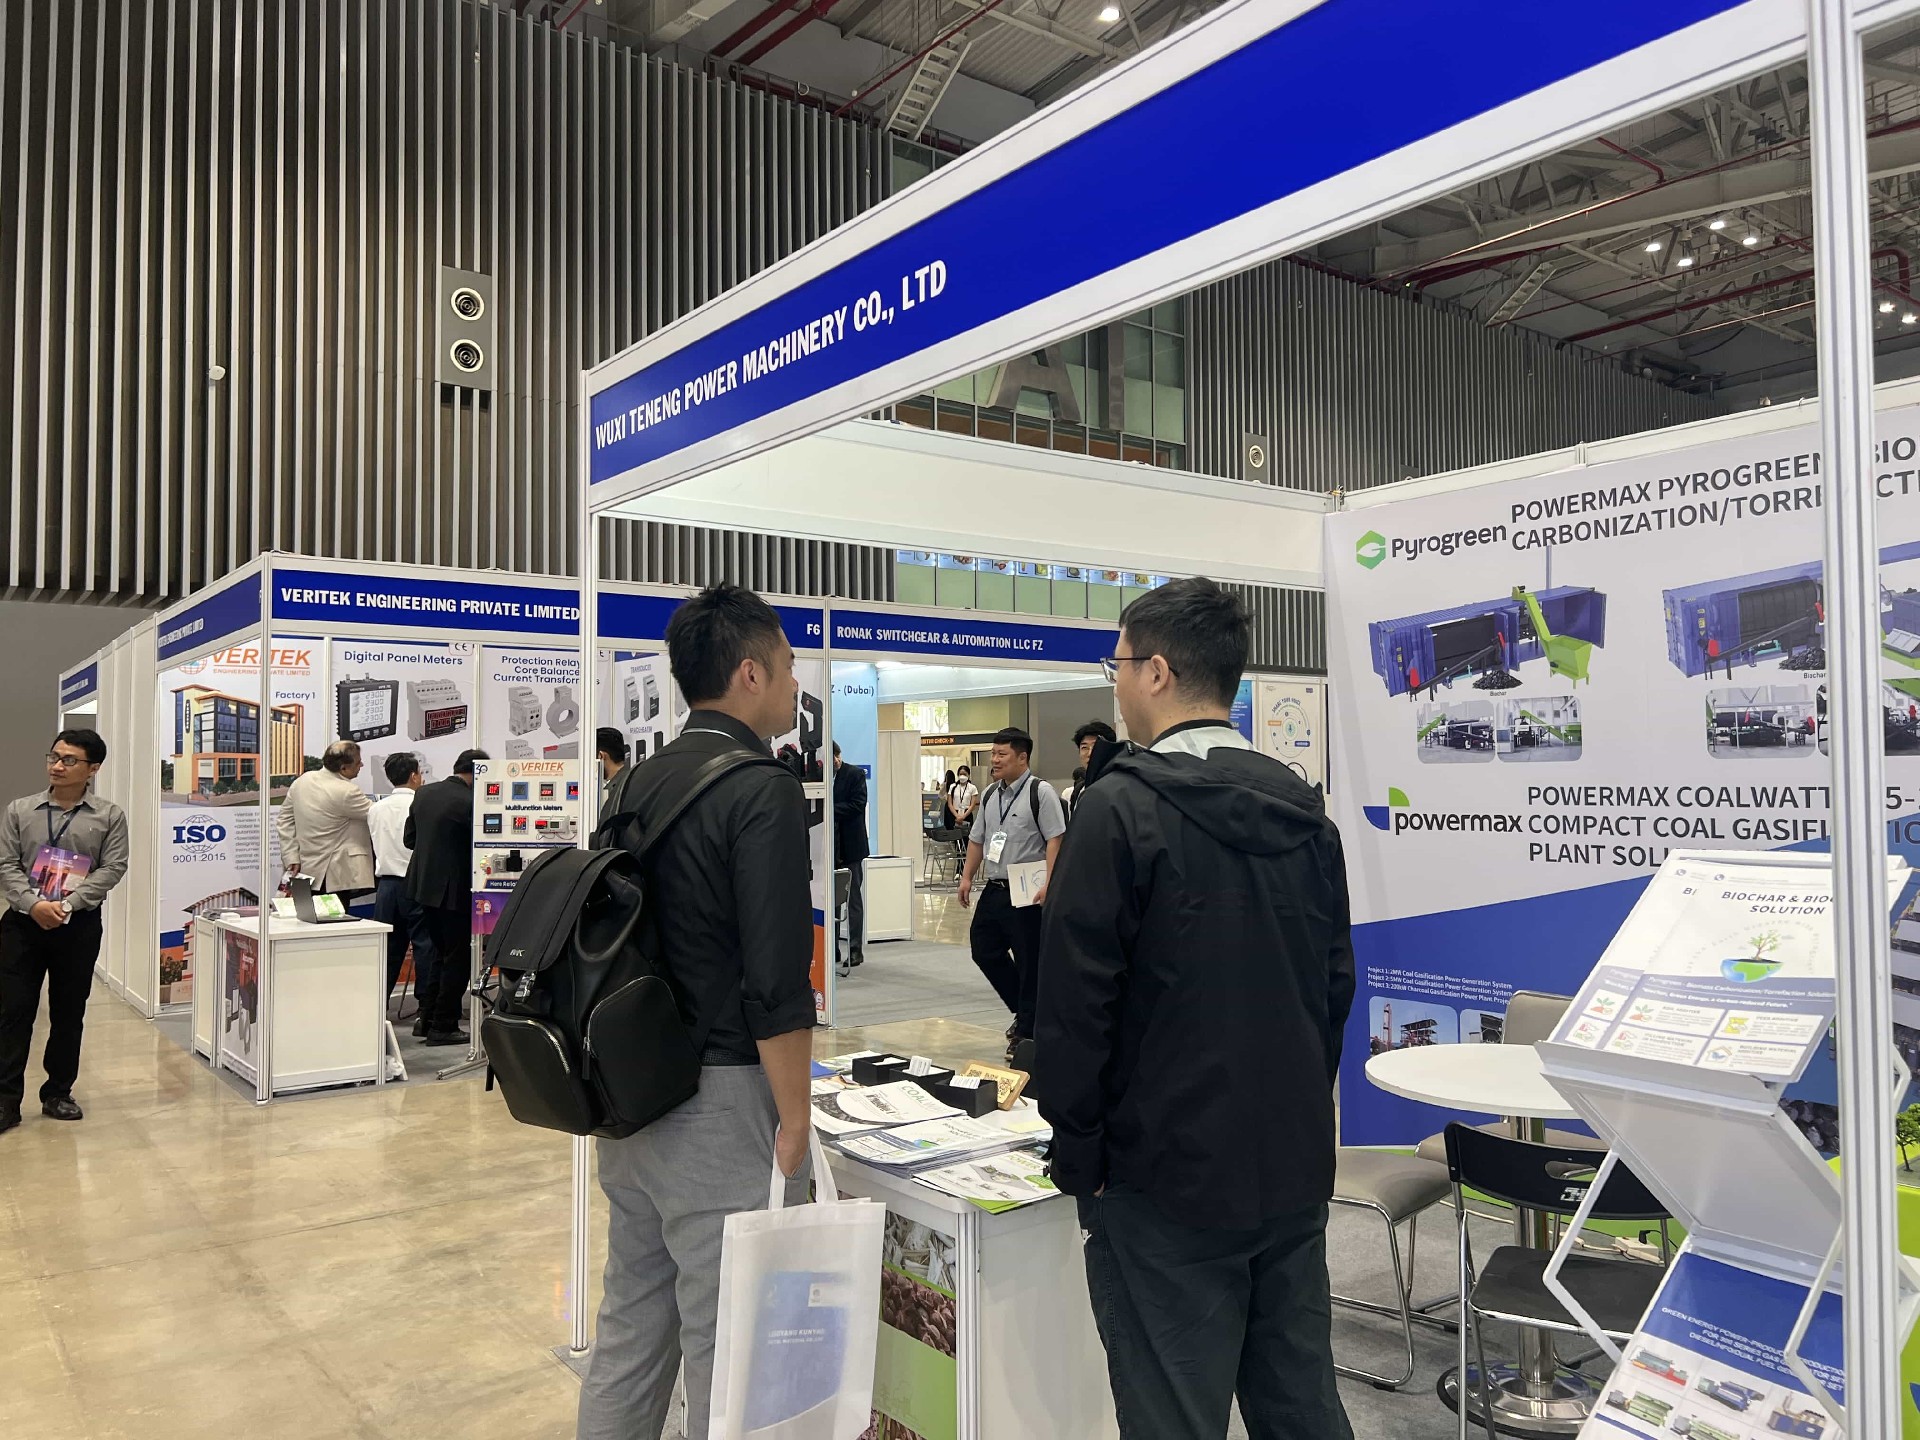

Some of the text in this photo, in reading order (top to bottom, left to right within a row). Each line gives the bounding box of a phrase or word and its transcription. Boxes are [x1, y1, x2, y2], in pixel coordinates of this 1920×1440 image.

[595, 259, 947, 450] WUXI TENENG POWER MACHINERY CO., LTD
[1511, 481, 1651, 524] POWERMAX
[1391, 524, 1507, 561] Pyrogreen
[281, 587, 580, 620] VERITEK ENGINEERING PRIVATE LIMITED
[806, 623, 821, 636] F6
[837, 626, 1044, 651] RONAK SWITCHGEAR & AUTOMATION LLC FZ
[212, 647, 311, 667] VERTEK
[344, 651, 464, 666] Digital Panel Meters
[501, 655, 553, 667] Protection
[493, 673, 532, 683] Current
[514, 665, 580, 676] Core Balance
[275, 691, 312, 701] Factory
[844, 684, 875, 697] (Dubai)
[521, 762, 565, 771] VERITEK
[1528, 786, 1670, 807] POWERMAX
[1676, 786, 1831, 809] COALWATT
[172, 824, 227, 844] ISO
[1395, 812, 1523, 836] powermax
[1528, 814, 1647, 837] COMPACT
[1653, 816, 1725, 840] COAL
[1529, 843, 1606, 865] PLANT
[1721, 891, 1784, 903] BIOCHAR
[1788, 895, 1800, 903] &
[1750, 905, 1826, 915] SOLUTION
[1367, 966, 1384, 974] Project
[1415, 972, 1443, 980] Gasification
[1445, 975, 1461, 983] Power
[1462, 978, 1491, 986] Generation
[1492, 981, 1512, 989] System
[1367, 973, 1384, 981] Project
[1415, 979, 1444, 988] Gasification
[1462, 985, 1491, 994] Generation
[1492, 988, 1513, 996] System
[1367, 980, 1385, 988] Project
[1408, 985, 1429, 994] Charcoal
[1430, 988, 1460, 998] Gasification
[1479, 994, 1493, 1002] Plant
[1662, 1307, 1687, 1321] GREEN
[1688, 1316, 1720, 1332] ENERGY
[1702, 1329, 1719, 1340] FOR
[1762, 1351, 1779, 1362] GAS
[1756, 1358, 1775, 1370] FUEL
